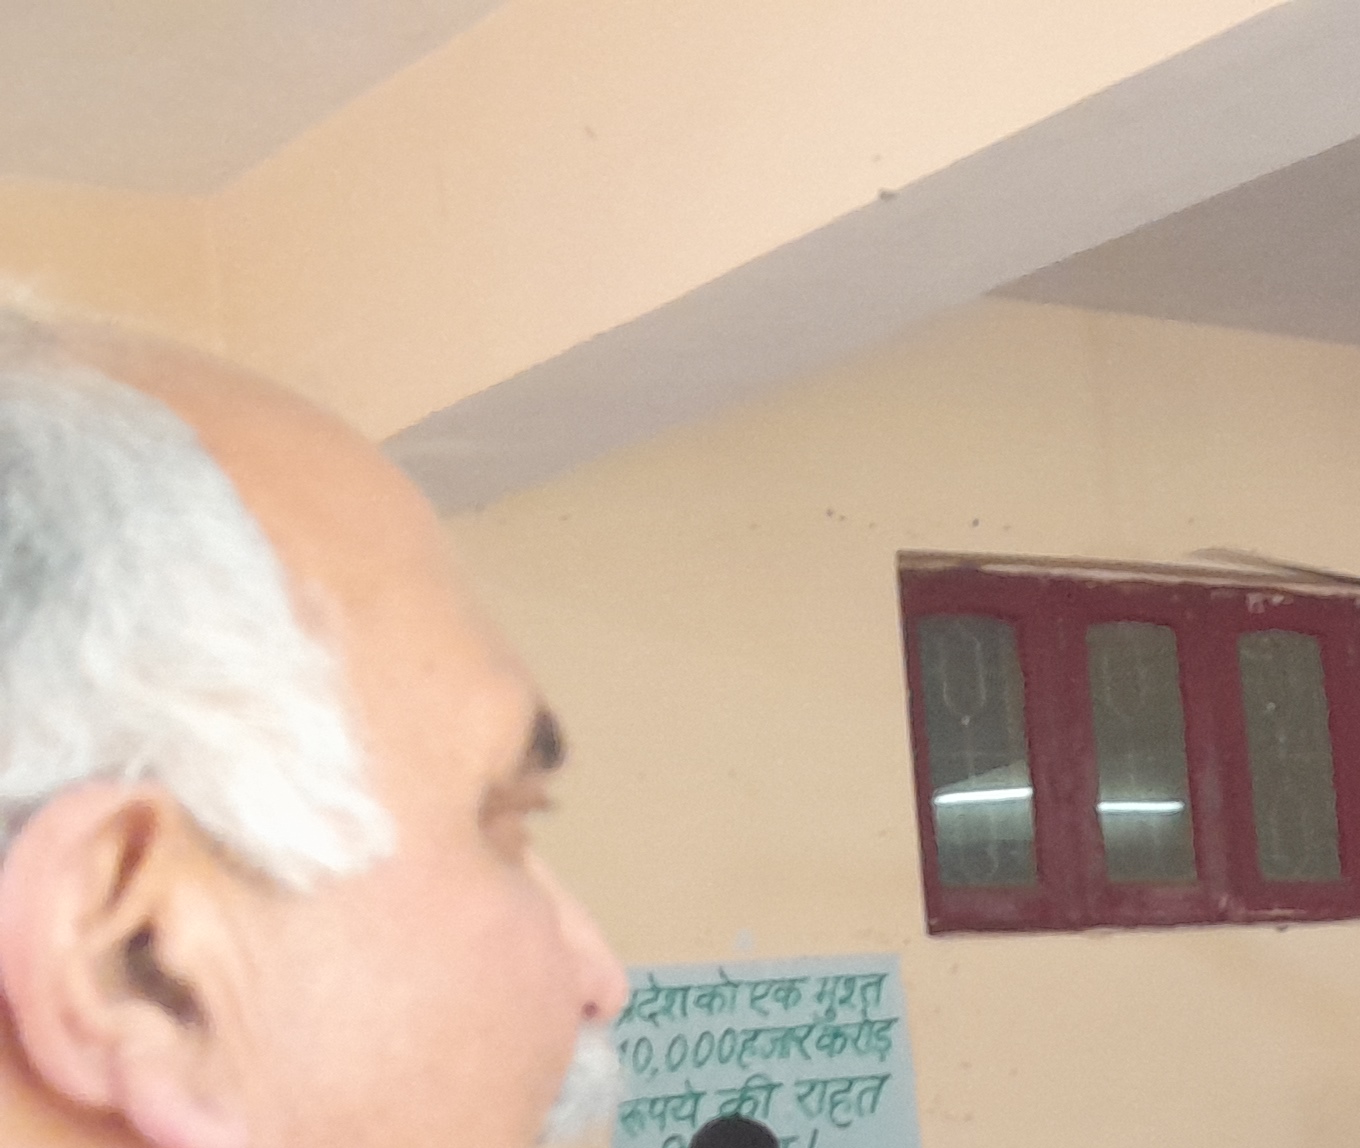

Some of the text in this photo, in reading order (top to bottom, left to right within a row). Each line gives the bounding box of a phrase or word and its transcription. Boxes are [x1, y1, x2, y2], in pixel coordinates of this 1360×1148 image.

[693, 965, 741, 1017] को
[742, 976, 811, 1017] एक
[794, 1073, 892, 1128] राहत
